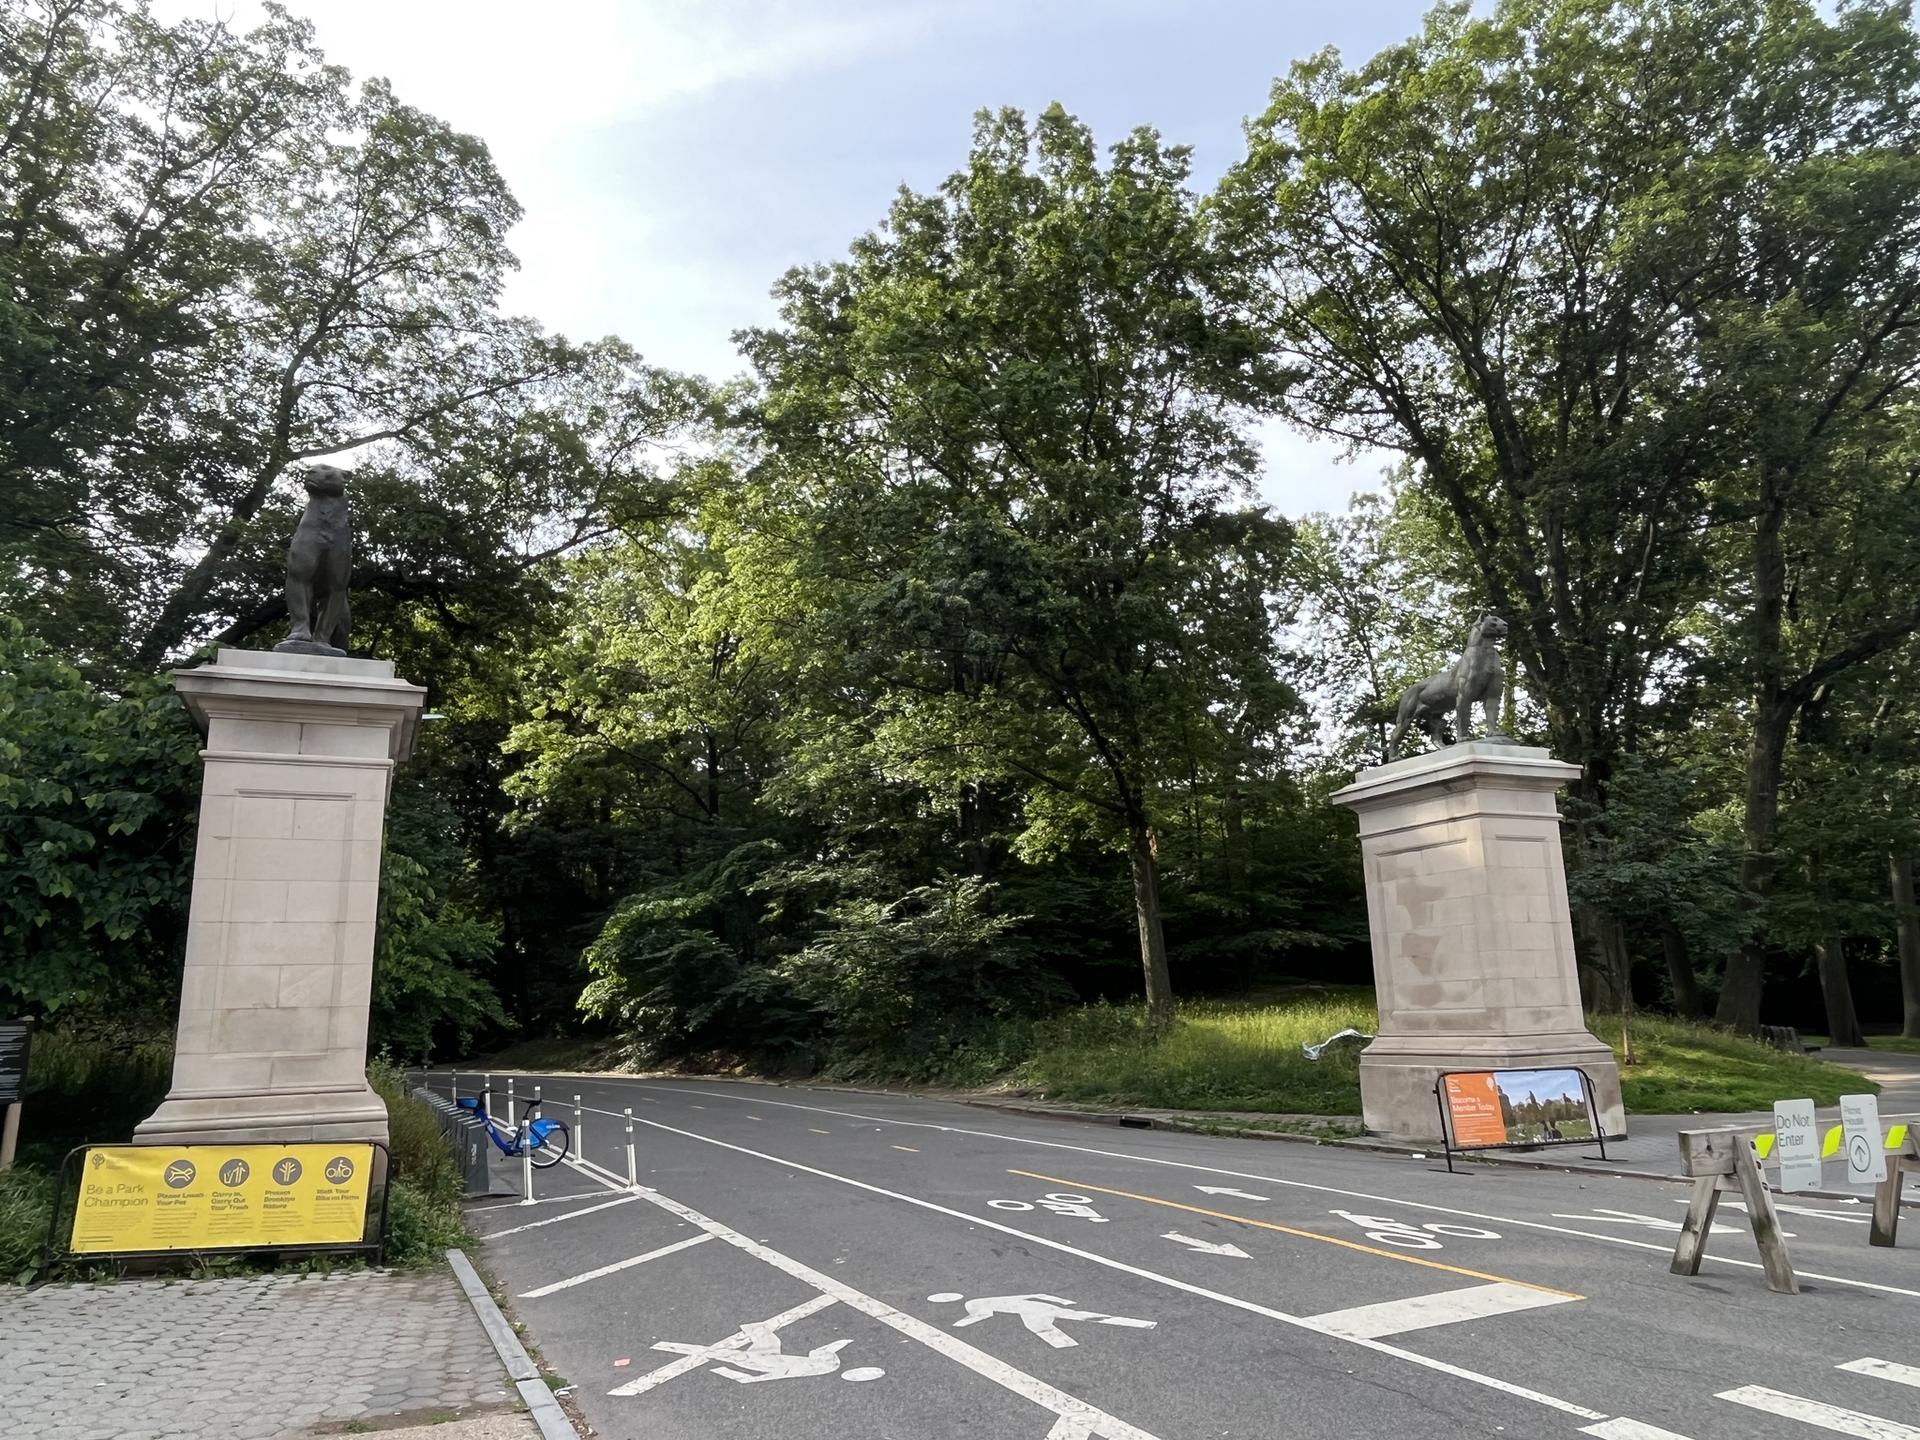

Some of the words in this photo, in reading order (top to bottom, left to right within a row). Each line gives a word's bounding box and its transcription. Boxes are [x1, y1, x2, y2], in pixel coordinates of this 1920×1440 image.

[1776, 1114, 1792, 1130] Do
[1792, 1113, 1810, 1128] Not
[1778, 1133, 1805, 1147] Enter
[86, 1184, 103, 1195] Be
[105, 1186, 113, 1195] a
[116, 1183, 145, 1194] Park
[84, 1195, 149, 1208] Champion
